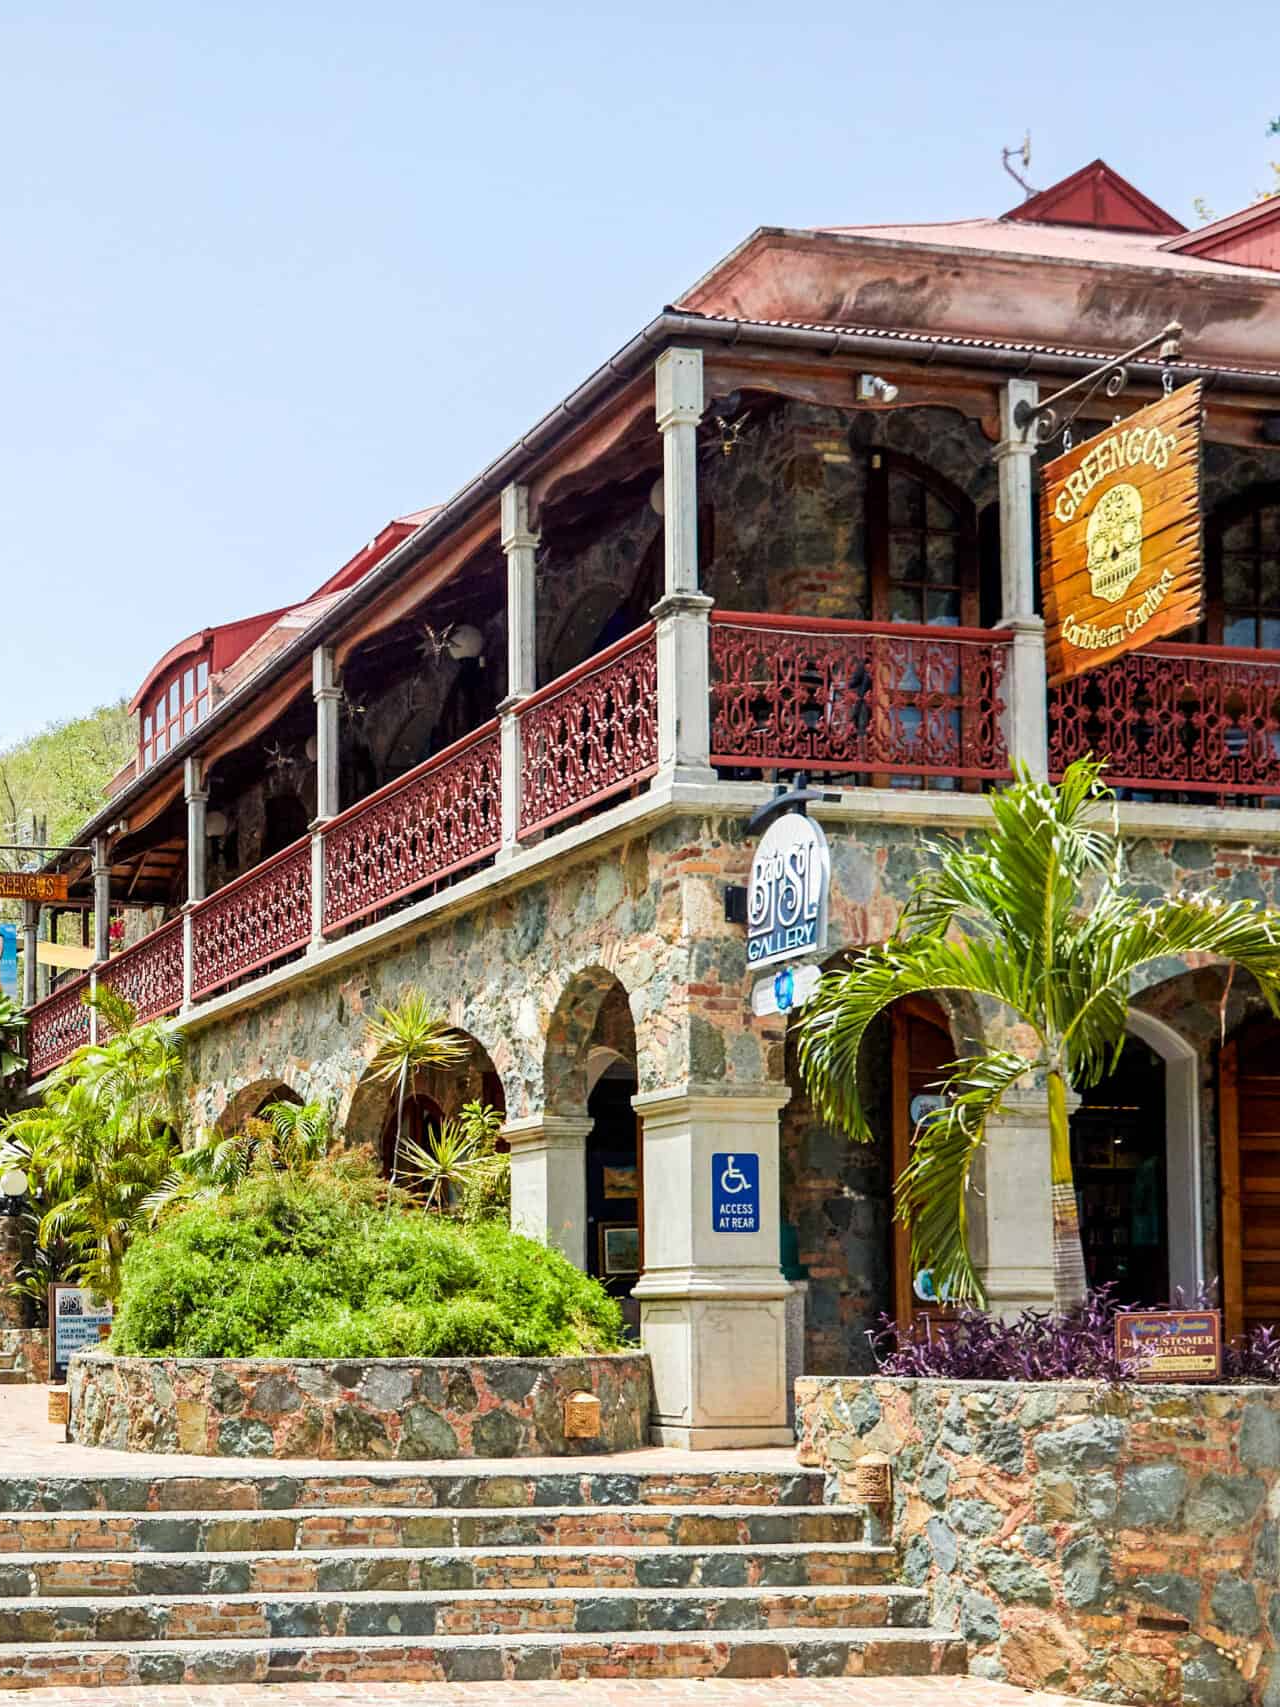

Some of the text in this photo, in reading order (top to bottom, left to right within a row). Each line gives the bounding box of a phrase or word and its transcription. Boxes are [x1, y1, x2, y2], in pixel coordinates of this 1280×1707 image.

[1055, 427, 1177, 523] GREENGOS
[1061, 567, 1175, 649] Caribbean Cantina
[748, 922, 815, 961] GALLERY
[720, 1203, 753, 1215] ACCESS
[720, 1217, 754, 1229] AT REAR
